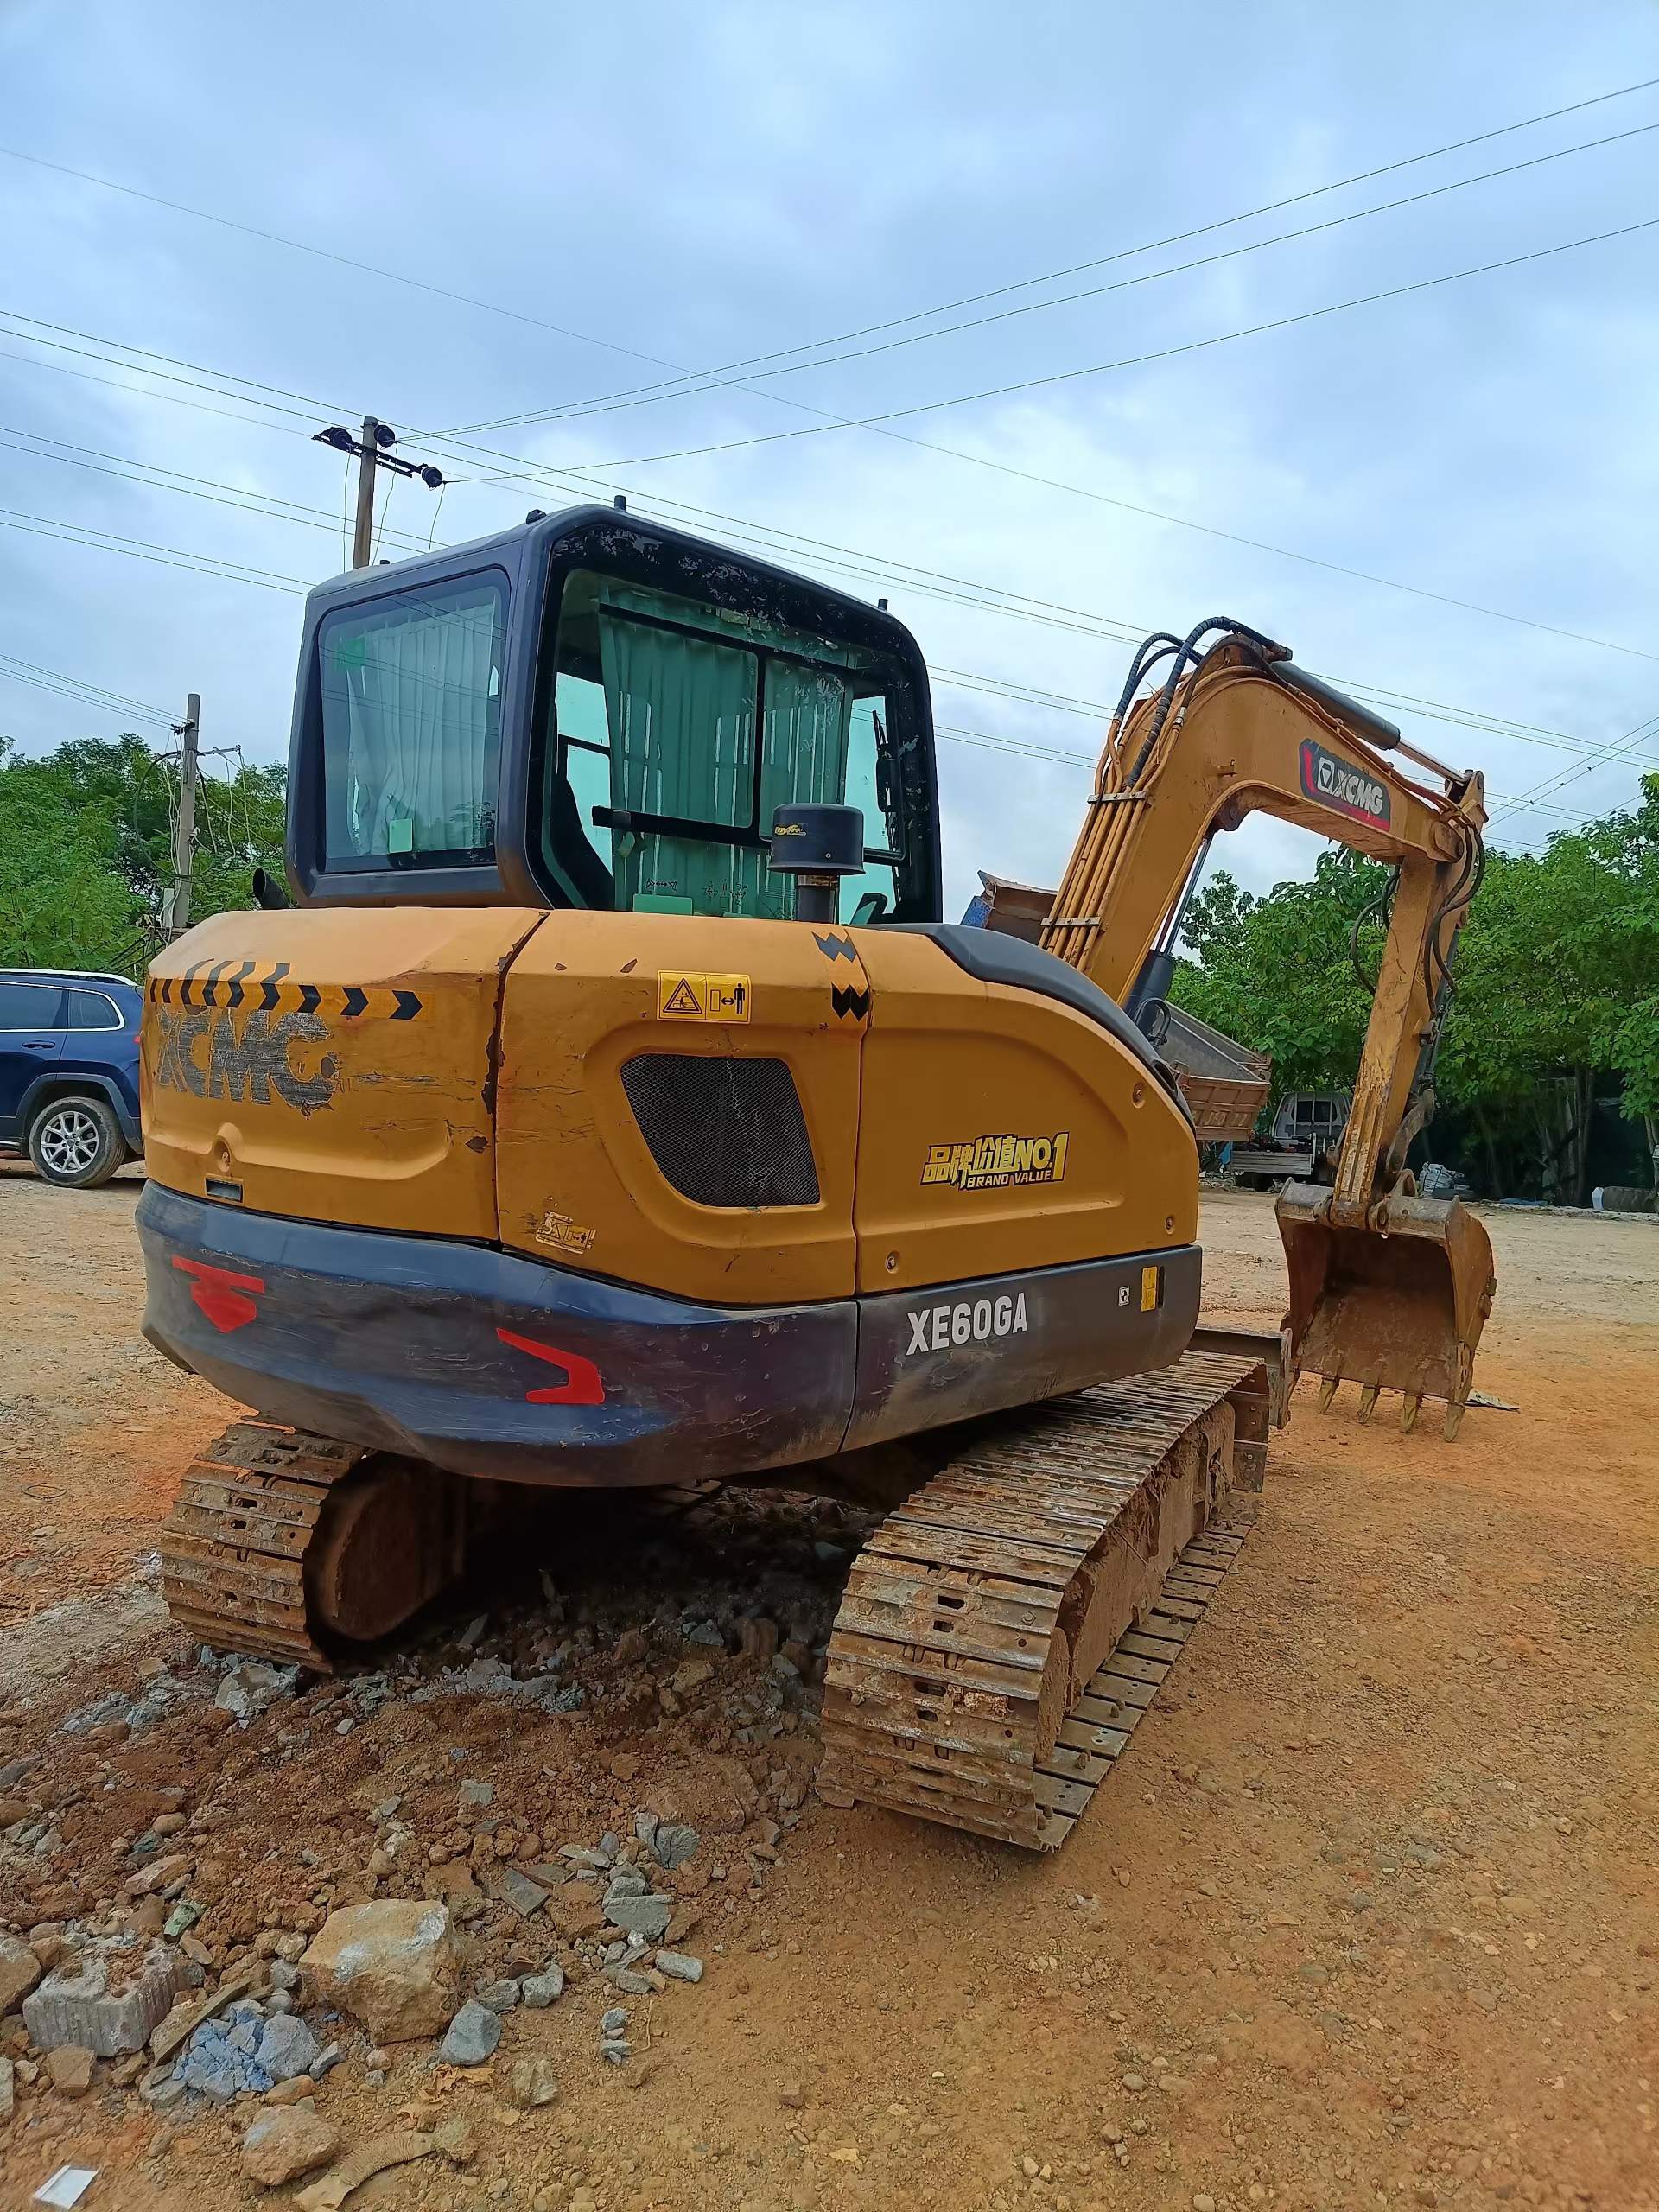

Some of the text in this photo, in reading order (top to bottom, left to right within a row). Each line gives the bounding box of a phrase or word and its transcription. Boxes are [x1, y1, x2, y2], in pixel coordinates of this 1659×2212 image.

[1332, 767, 1383, 815] XCMG
[966, 1169, 1052, 1188] BRAND VALUE
[906, 1292, 1027, 1356] XE60GA
